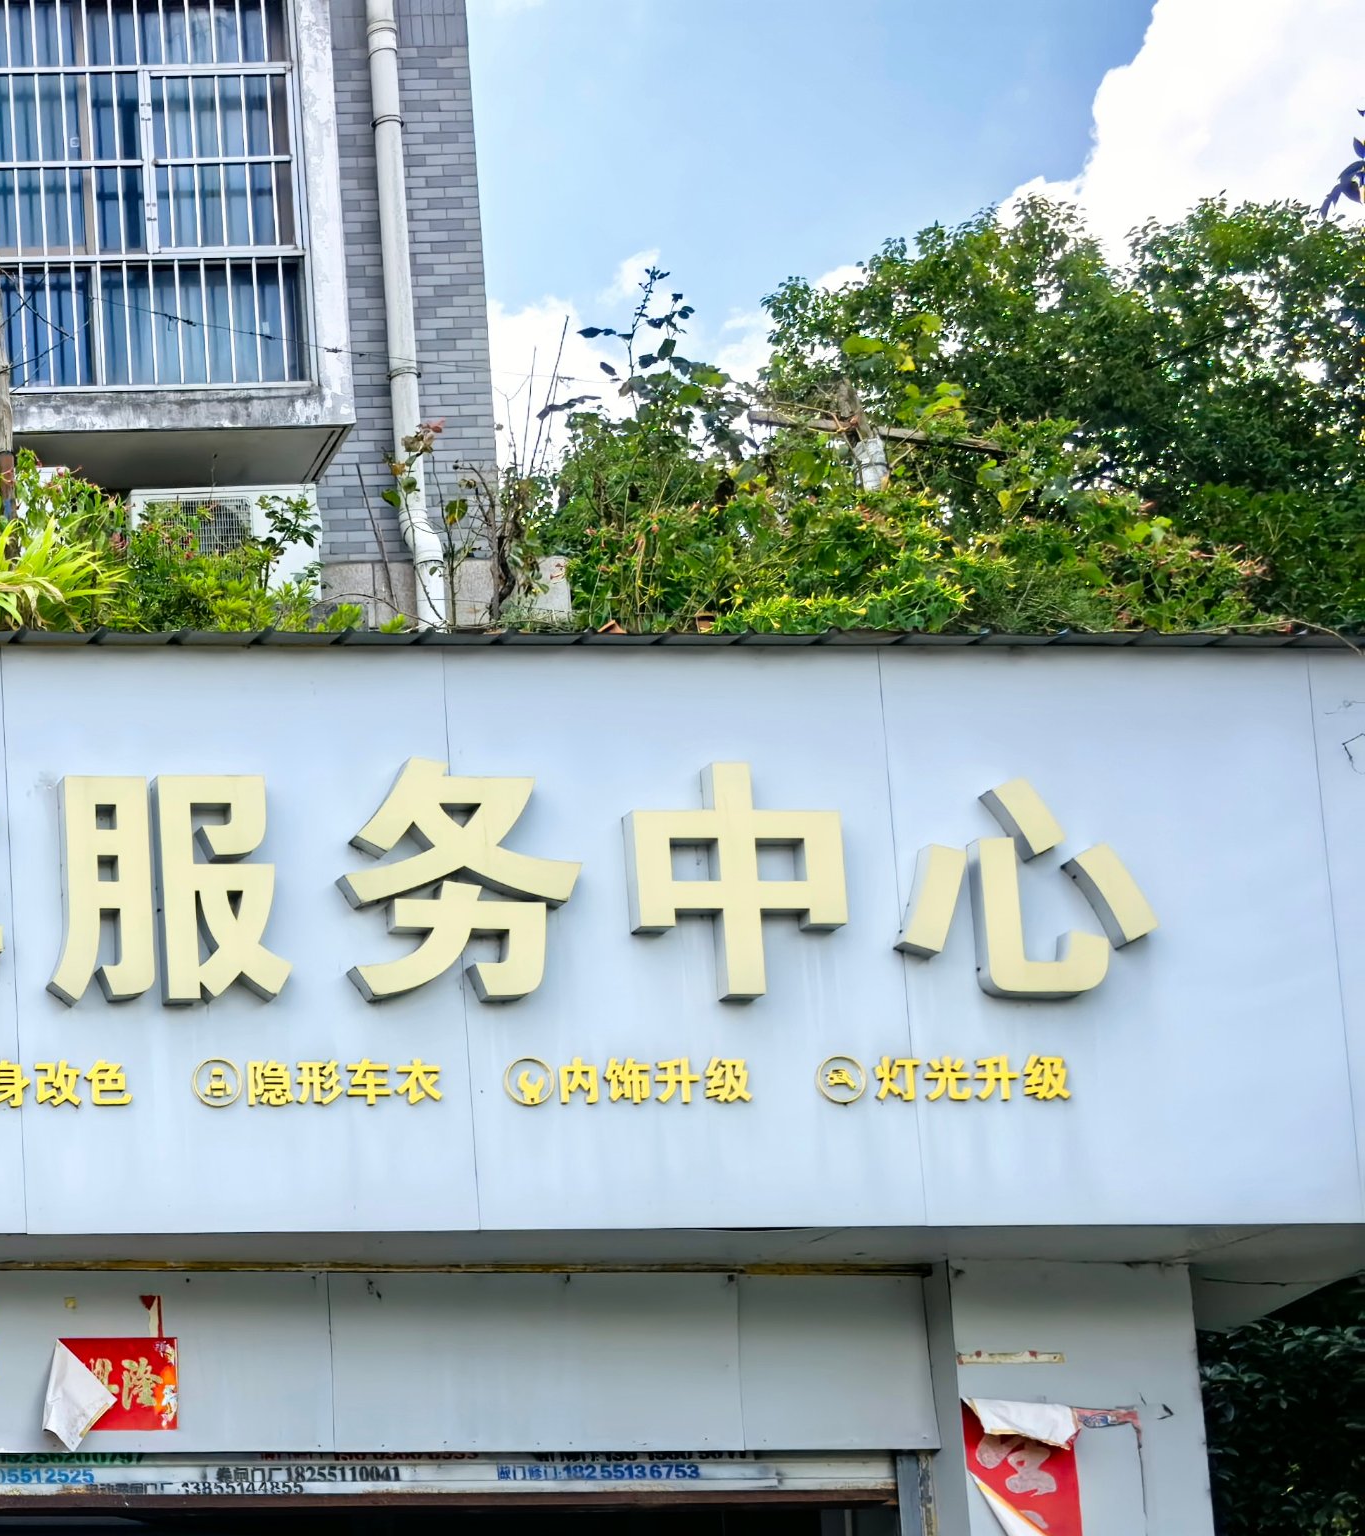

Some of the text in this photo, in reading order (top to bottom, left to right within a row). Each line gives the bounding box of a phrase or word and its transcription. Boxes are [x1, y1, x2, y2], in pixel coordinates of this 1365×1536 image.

[247, 1058, 443, 1106] 隐形车衣
[558, 1056, 753, 1104] 内饰升级
[874, 1053, 1072, 1102] 灯光升级
[649, 1464, 701, 1480] 6753
